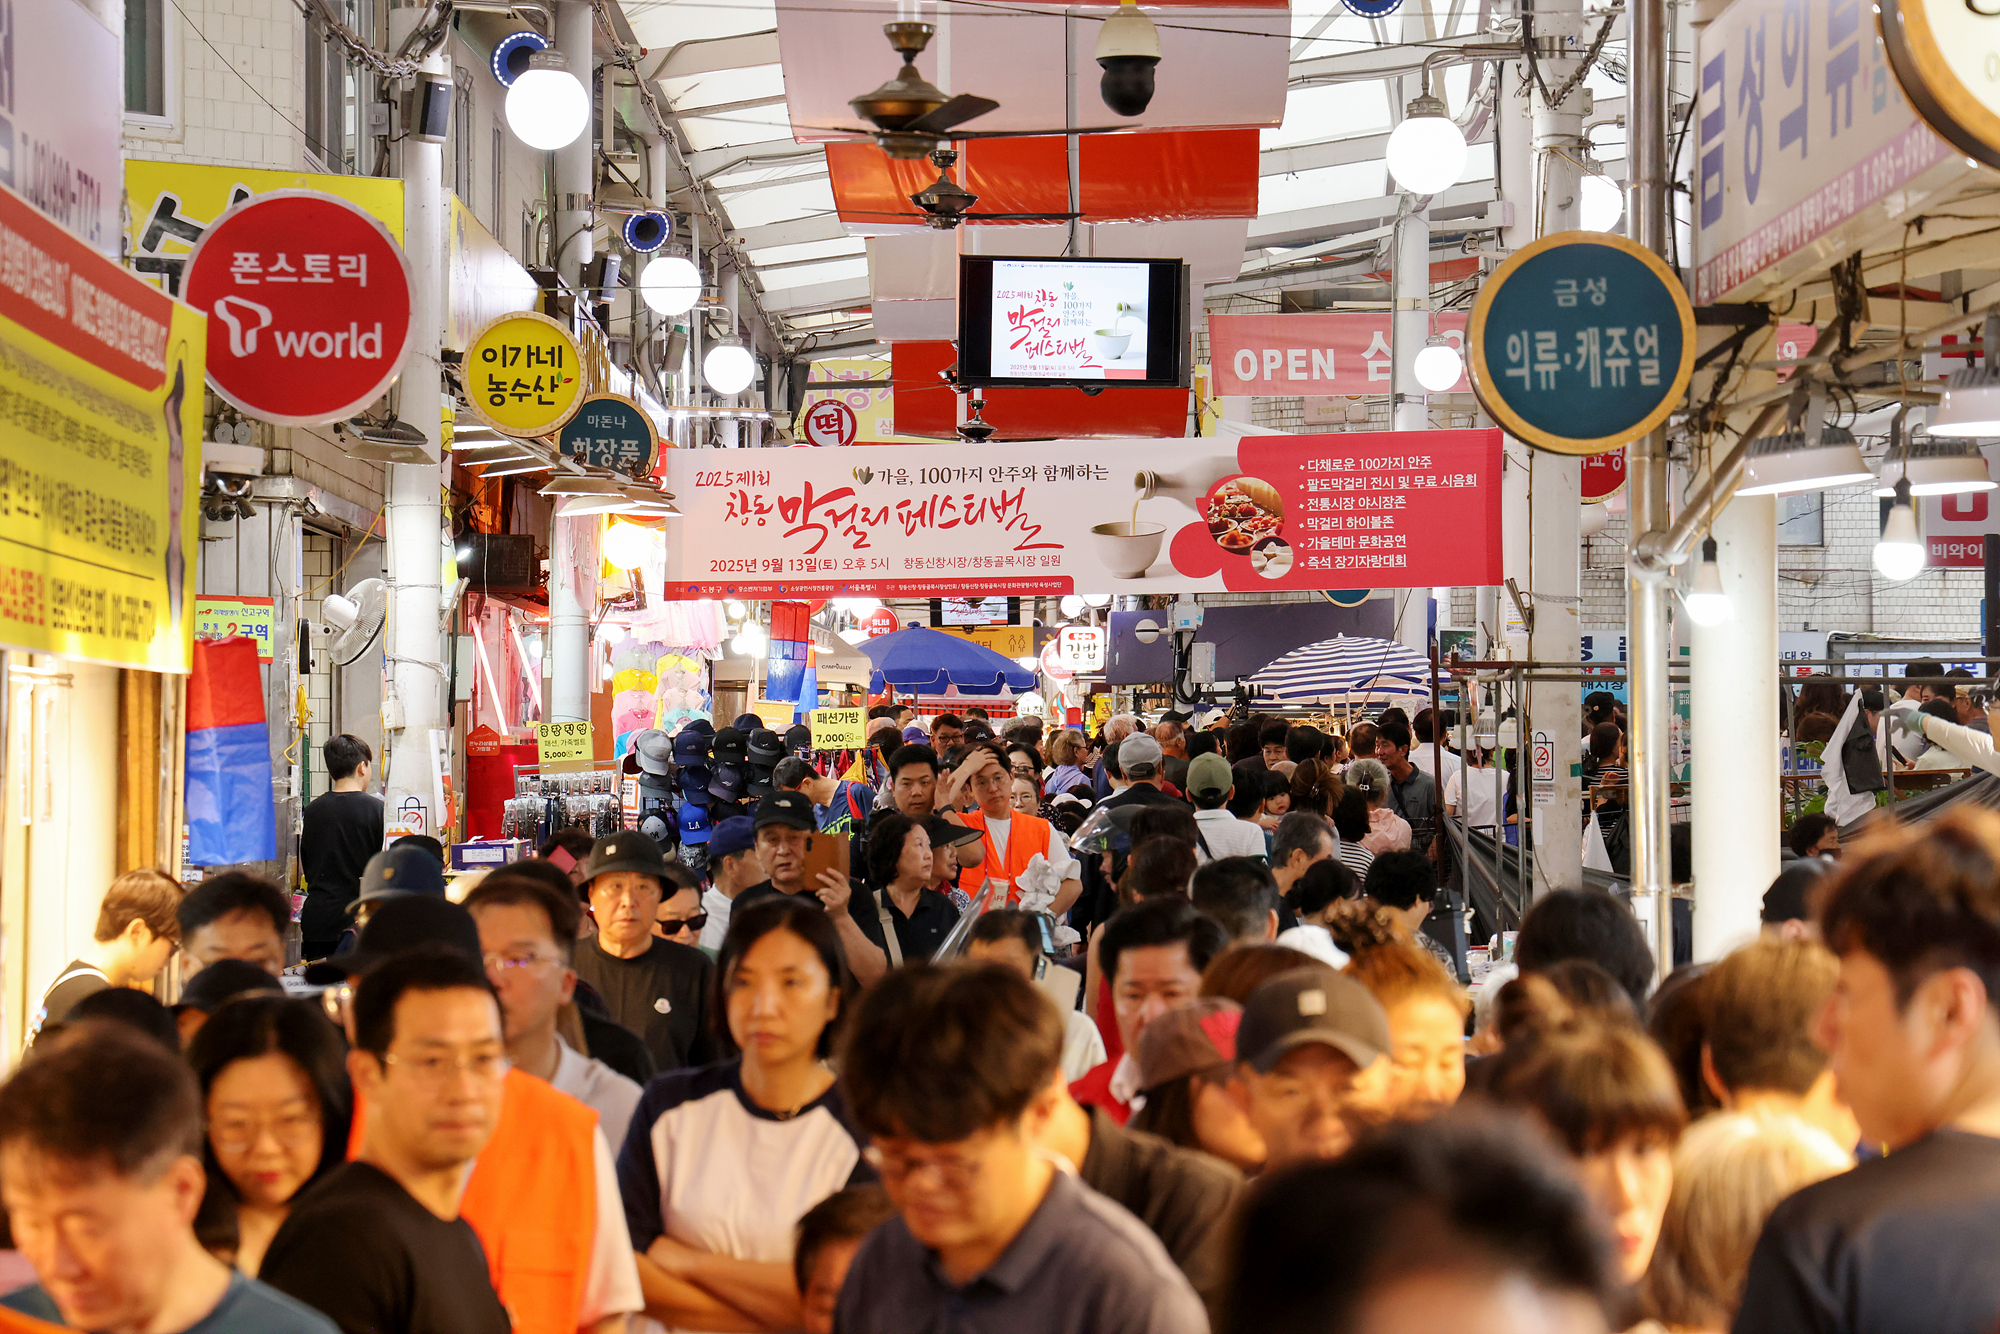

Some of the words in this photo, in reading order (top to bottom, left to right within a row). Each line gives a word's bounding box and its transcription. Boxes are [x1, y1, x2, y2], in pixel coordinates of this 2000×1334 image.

[230, 252, 367, 287] 폰스토리
[1553, 277, 1608, 307] 금성
[1063, 301, 1092, 310] 100가지
[1008, 304, 1060, 350] 막걸리
[1063, 318, 1092, 327] 함께하는
[274, 322, 382, 359] world
[482, 345, 562, 368] 이가네
[1025, 338, 1103, 368] 페스티벌
[1505, 324, 1660, 391] 의류·캐쥬얼
[1234, 348, 1335, 381] OPEN
[488, 374, 559, 406] 농수산
[587, 415, 627, 429] 마돈나
[813, 408, 844, 444] 떡
[1307, 458, 1355, 471] 다채로운
[1359, 457, 1404, 470] 100가지
[1407, 456, 1433, 469] 안주
[877, 469, 913, 486] 가을,
[919, 466, 983, 485] 100가지
[988, 465, 1038, 483] 안주와
[1043, 464, 1109, 482] 함께하는
[1307, 477, 1367, 491] 팔도막걸리
[1370, 476, 1394, 490] 전시
[1398, 476, 1410, 489] 및
[1413, 476, 1438, 488] 무료
[1440, 474, 1478, 487] 시음회
[1307, 497, 1355, 511] 전통시장
[1358, 495, 1407, 509] 야시장존
[724, 489, 774, 526] 창동
[778, 481, 889, 555] 막걸리
[896, 487, 1065, 551] 페스티벌
[1307, 517, 1343, 530] 막걸리
[1345, 515, 1395, 529] 하이볼존
[1307, 536, 1355, 550] 가을테마
[1358, 534, 1407, 548] 문화공연
[710, 559, 757, 573] 2025년
[762, 558, 783, 573] 9월
[788, 557, 838, 573] 13일(토)
[842, 557, 866, 570] 오후
[870, 557, 889, 570] 5시
[903, 556, 1036, 570] 창동신창시장/창동골목시장
[1040, 555, 1061, 568] 일원
[1307, 556, 1332, 569] 즉석
[1334, 554, 1407, 568] 장기자랑대회
[848, 584, 877, 592] 서울특별시
[241, 608, 270, 617] 신고구역
[241, 624, 268, 641] 구역
[1066, 643, 1099, 659] 김밥
[817, 712, 859, 724] 패션가방
[816, 732, 854, 743] 7,000원
[688, 821, 701, 830] LA
